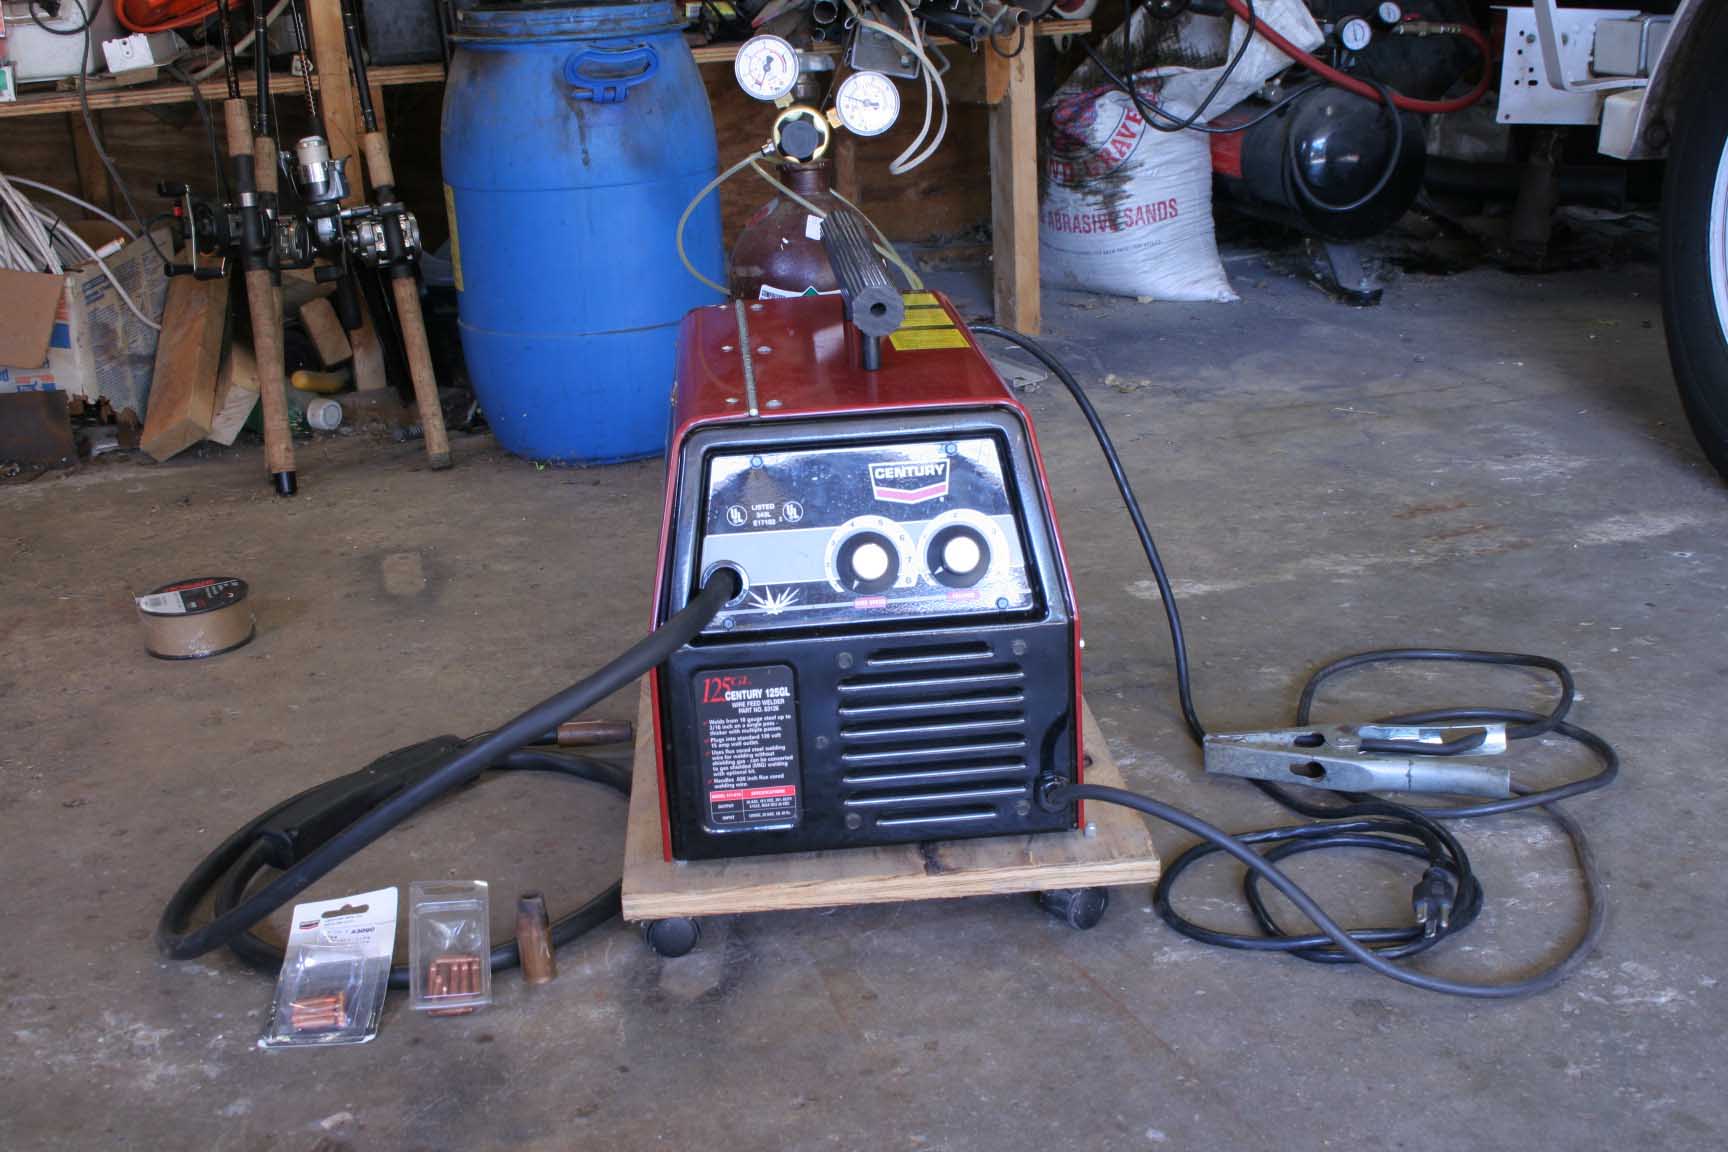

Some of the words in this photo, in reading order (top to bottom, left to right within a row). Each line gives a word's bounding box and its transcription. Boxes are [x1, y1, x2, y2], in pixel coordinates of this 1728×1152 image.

[1123, 197, 1178, 228] SANDS
[874, 463, 945, 480] CENTURY
[751, 503, 775, 511] LISTED
[703, 676, 734, 703] 125
[725, 688, 763, 701] CENTURY
[765, 686, 790, 698] 125GL
[731, 700, 746, 708] WIRE
